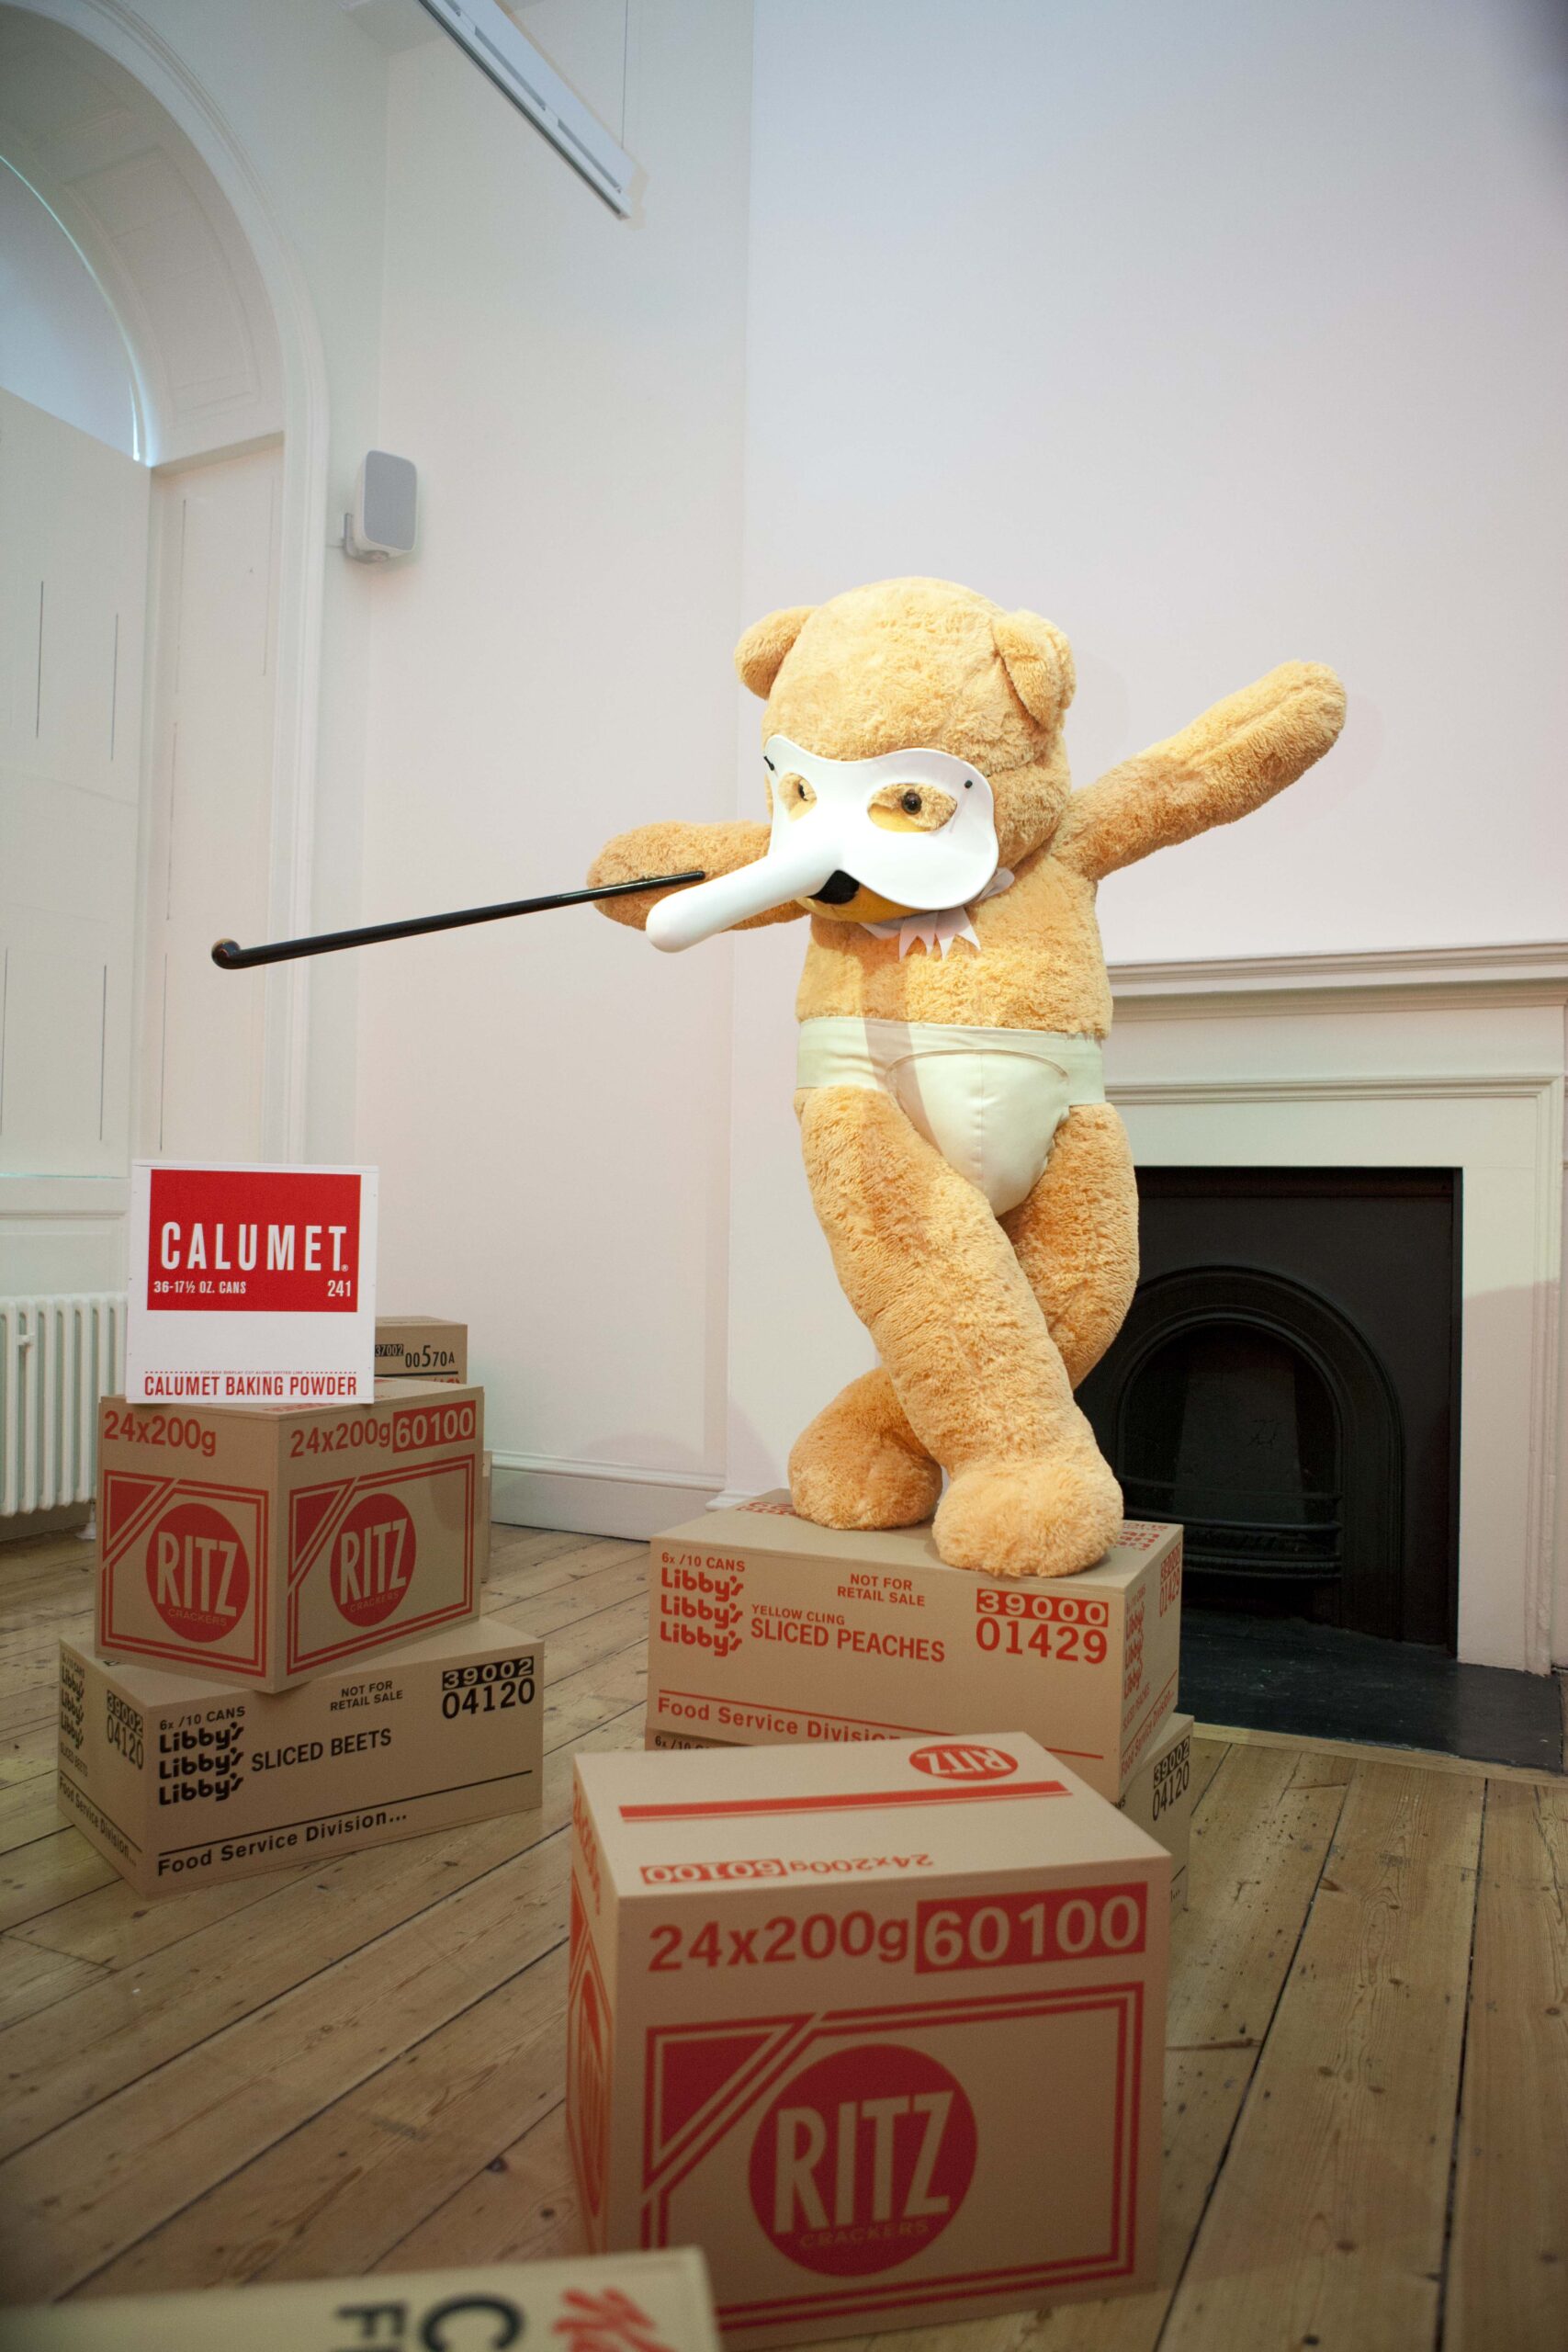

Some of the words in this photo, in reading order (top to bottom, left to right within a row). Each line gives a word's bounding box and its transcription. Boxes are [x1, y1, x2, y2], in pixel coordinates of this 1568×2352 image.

[199, 1281, 215, 1294] OZ.
[219, 1281, 246, 1295] CANS
[327, 1279, 351, 1297] 241
[144, 1376, 220, 1396] CALUMET
[226, 1376, 283, 1396] BAKING
[290, 1376, 356, 1396] POWDER
[104, 1410, 217, 1457] 24x200g
[290, 1419, 390, 1458] 24x200g
[395, 1407, 475, 1449] 60100
[157, 1531, 238, 1617] RITZ
[340, 1518, 407, 1605] RITZ
[706, 1556, 745, 1572] CANS
[661, 1566, 744, 1602] Libby's
[837, 1586, 885, 1602] RETAIL
[889, 1592, 925, 1607] SALE
[851, 1574, 878, 1588] NOT
[884, 1577, 912, 1591] FOR
[168, 1608, 227, 1626] CRACKERS
[350, 1591, 399, 1612] CRACKERS
[660, 1594, 743, 1630] Libby's
[751, 1604, 802, 1620] YELLOW
[807, 1611, 845, 1625] CLING
[978, 1590, 1107, 1625] 39000
[660, 1621, 742, 1657] Libby's
[750, 1617, 829, 1647] SLICED
[837, 1629, 945, 1663] PEACHES
[976, 1616, 1107, 1664] 01429
[341, 1686, 365, 1698] NOT
[369, 1680, 393, 1693] FOR
[444, 1657, 533, 1690] 39002
[206, 1706, 246, 1723] CANS
[330, 1697, 370, 1712] RETAIL
[374, 1690, 403, 1704] SALE
[442, 1678, 536, 1720] 04120
[658, 1697, 709, 1721] Food
[717, 1705, 798, 1735] Service
[107, 1713, 143, 1770] 04120
[159, 1722, 244, 1754] Libby's
[251, 1742, 323, 1772] SLICED
[331, 1728, 392, 1757] BEETS
[159, 1747, 244, 1780] Libby's
[916, 1748, 1012, 1775] RITZ
[1154, 1736, 1190, 1789] 39002
[159, 1772, 243, 1805] Libby's
[1152, 1759, 1190, 1822] 04120
[158, 1849, 212, 1876] Food
[220, 1833, 298, 1861] Service
[647, 1860, 781, 1883] 60100
[790, 1853, 933, 1875] 24x200g
[648, 1911, 908, 1972] 24x200g
[923, 1895, 1140, 1965] 60100
[773, 2090, 954, 2235] RITZ
